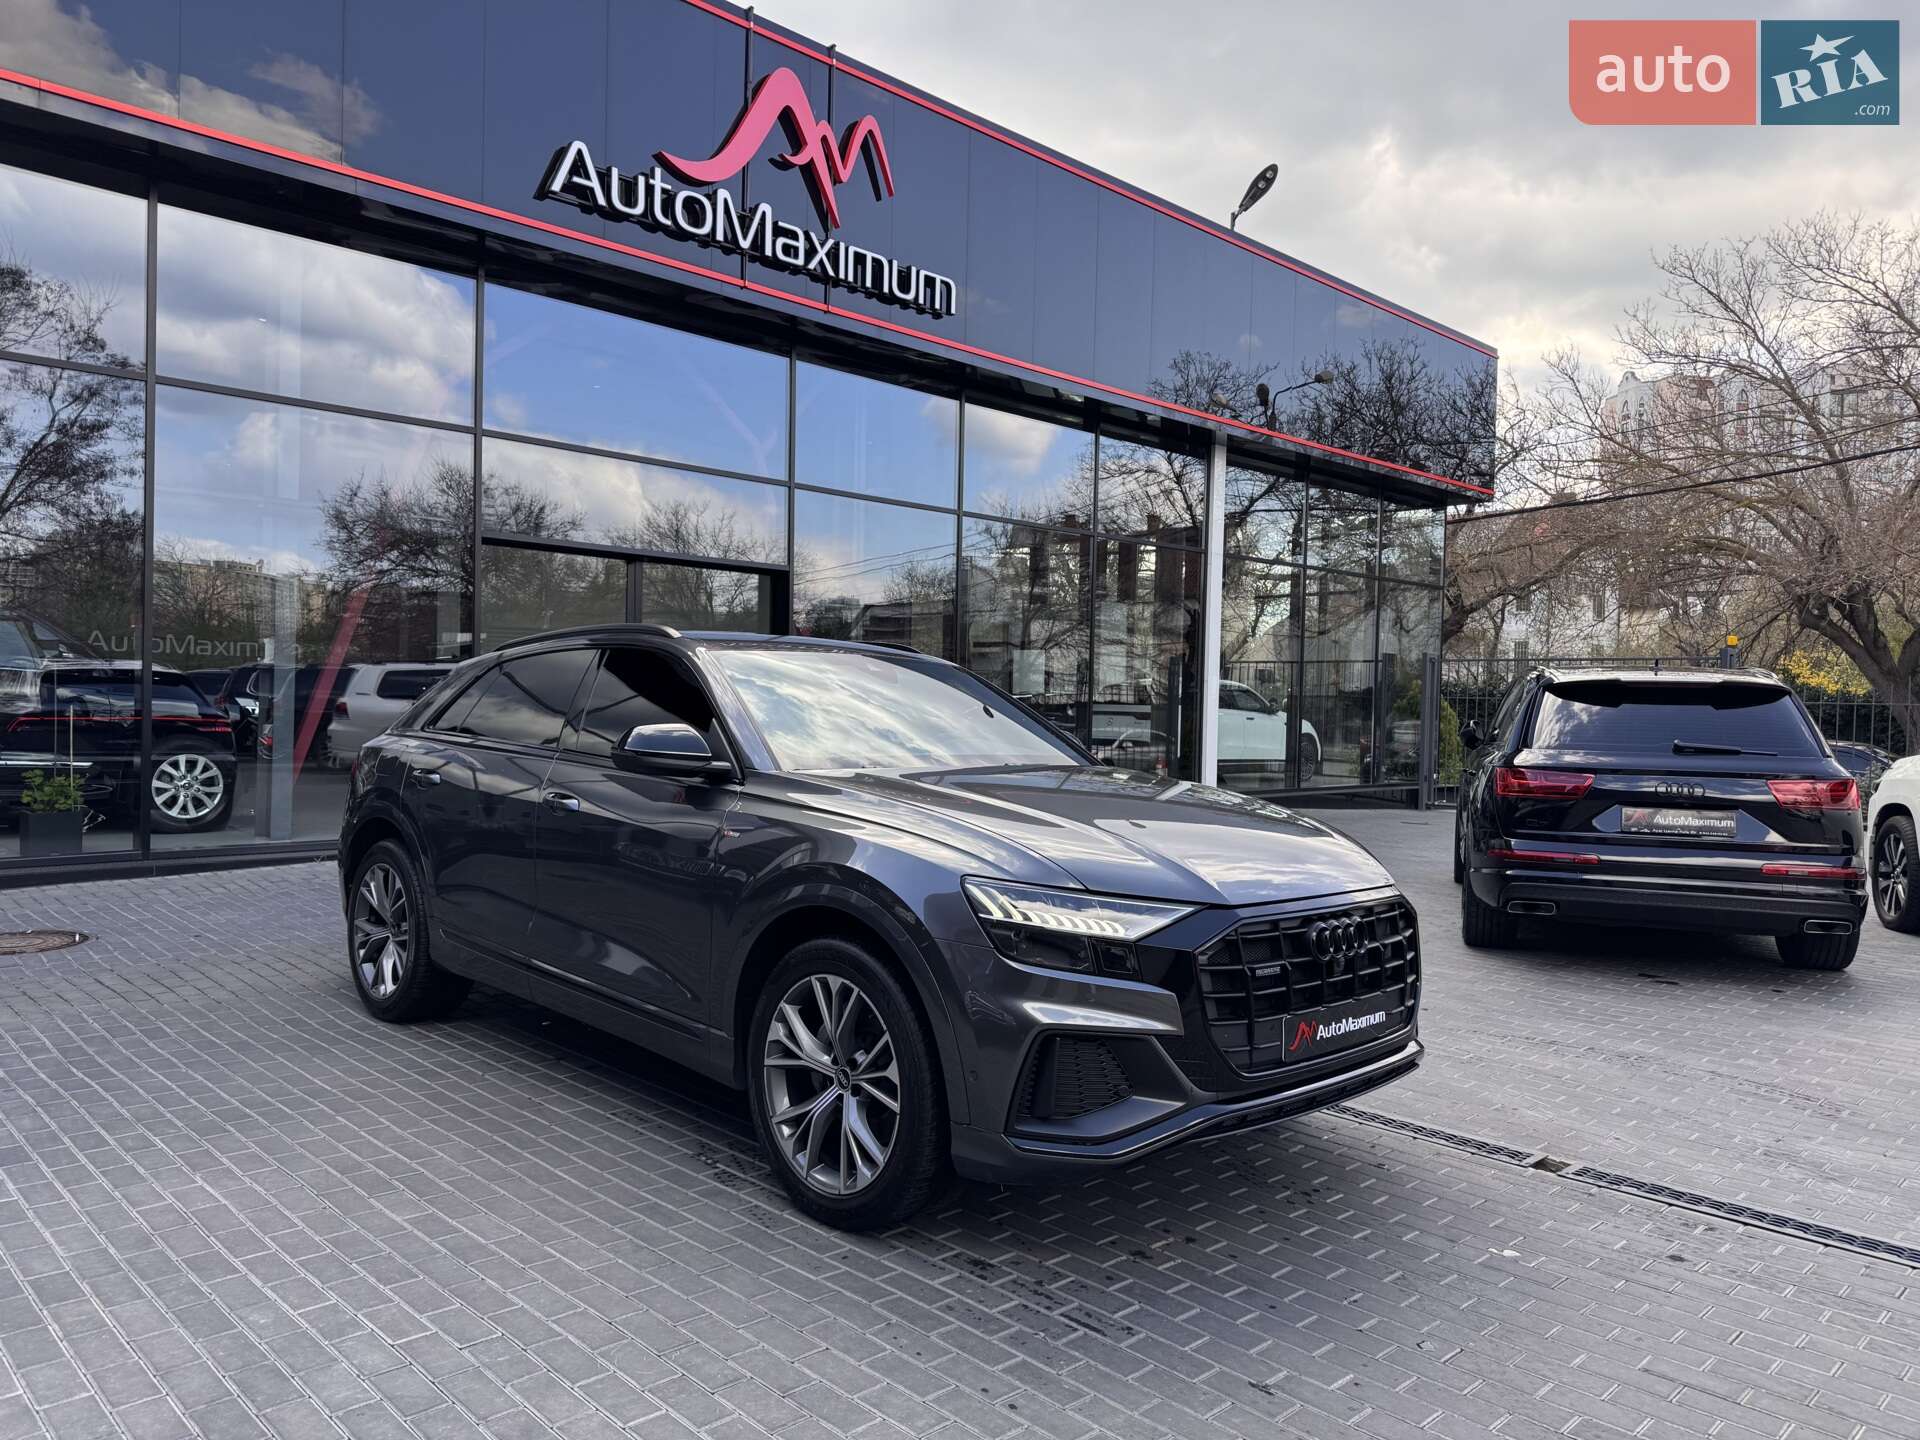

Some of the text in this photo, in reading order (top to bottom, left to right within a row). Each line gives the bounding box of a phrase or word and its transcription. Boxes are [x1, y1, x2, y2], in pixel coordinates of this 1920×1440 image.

[551, 140, 957, 316] AutoMaximum
[88, 630, 299, 658] AuoMaxim
[1654, 814, 1734, 828] AutoMaximum
[1317, 1011, 1386, 1040] AutoMaximum
